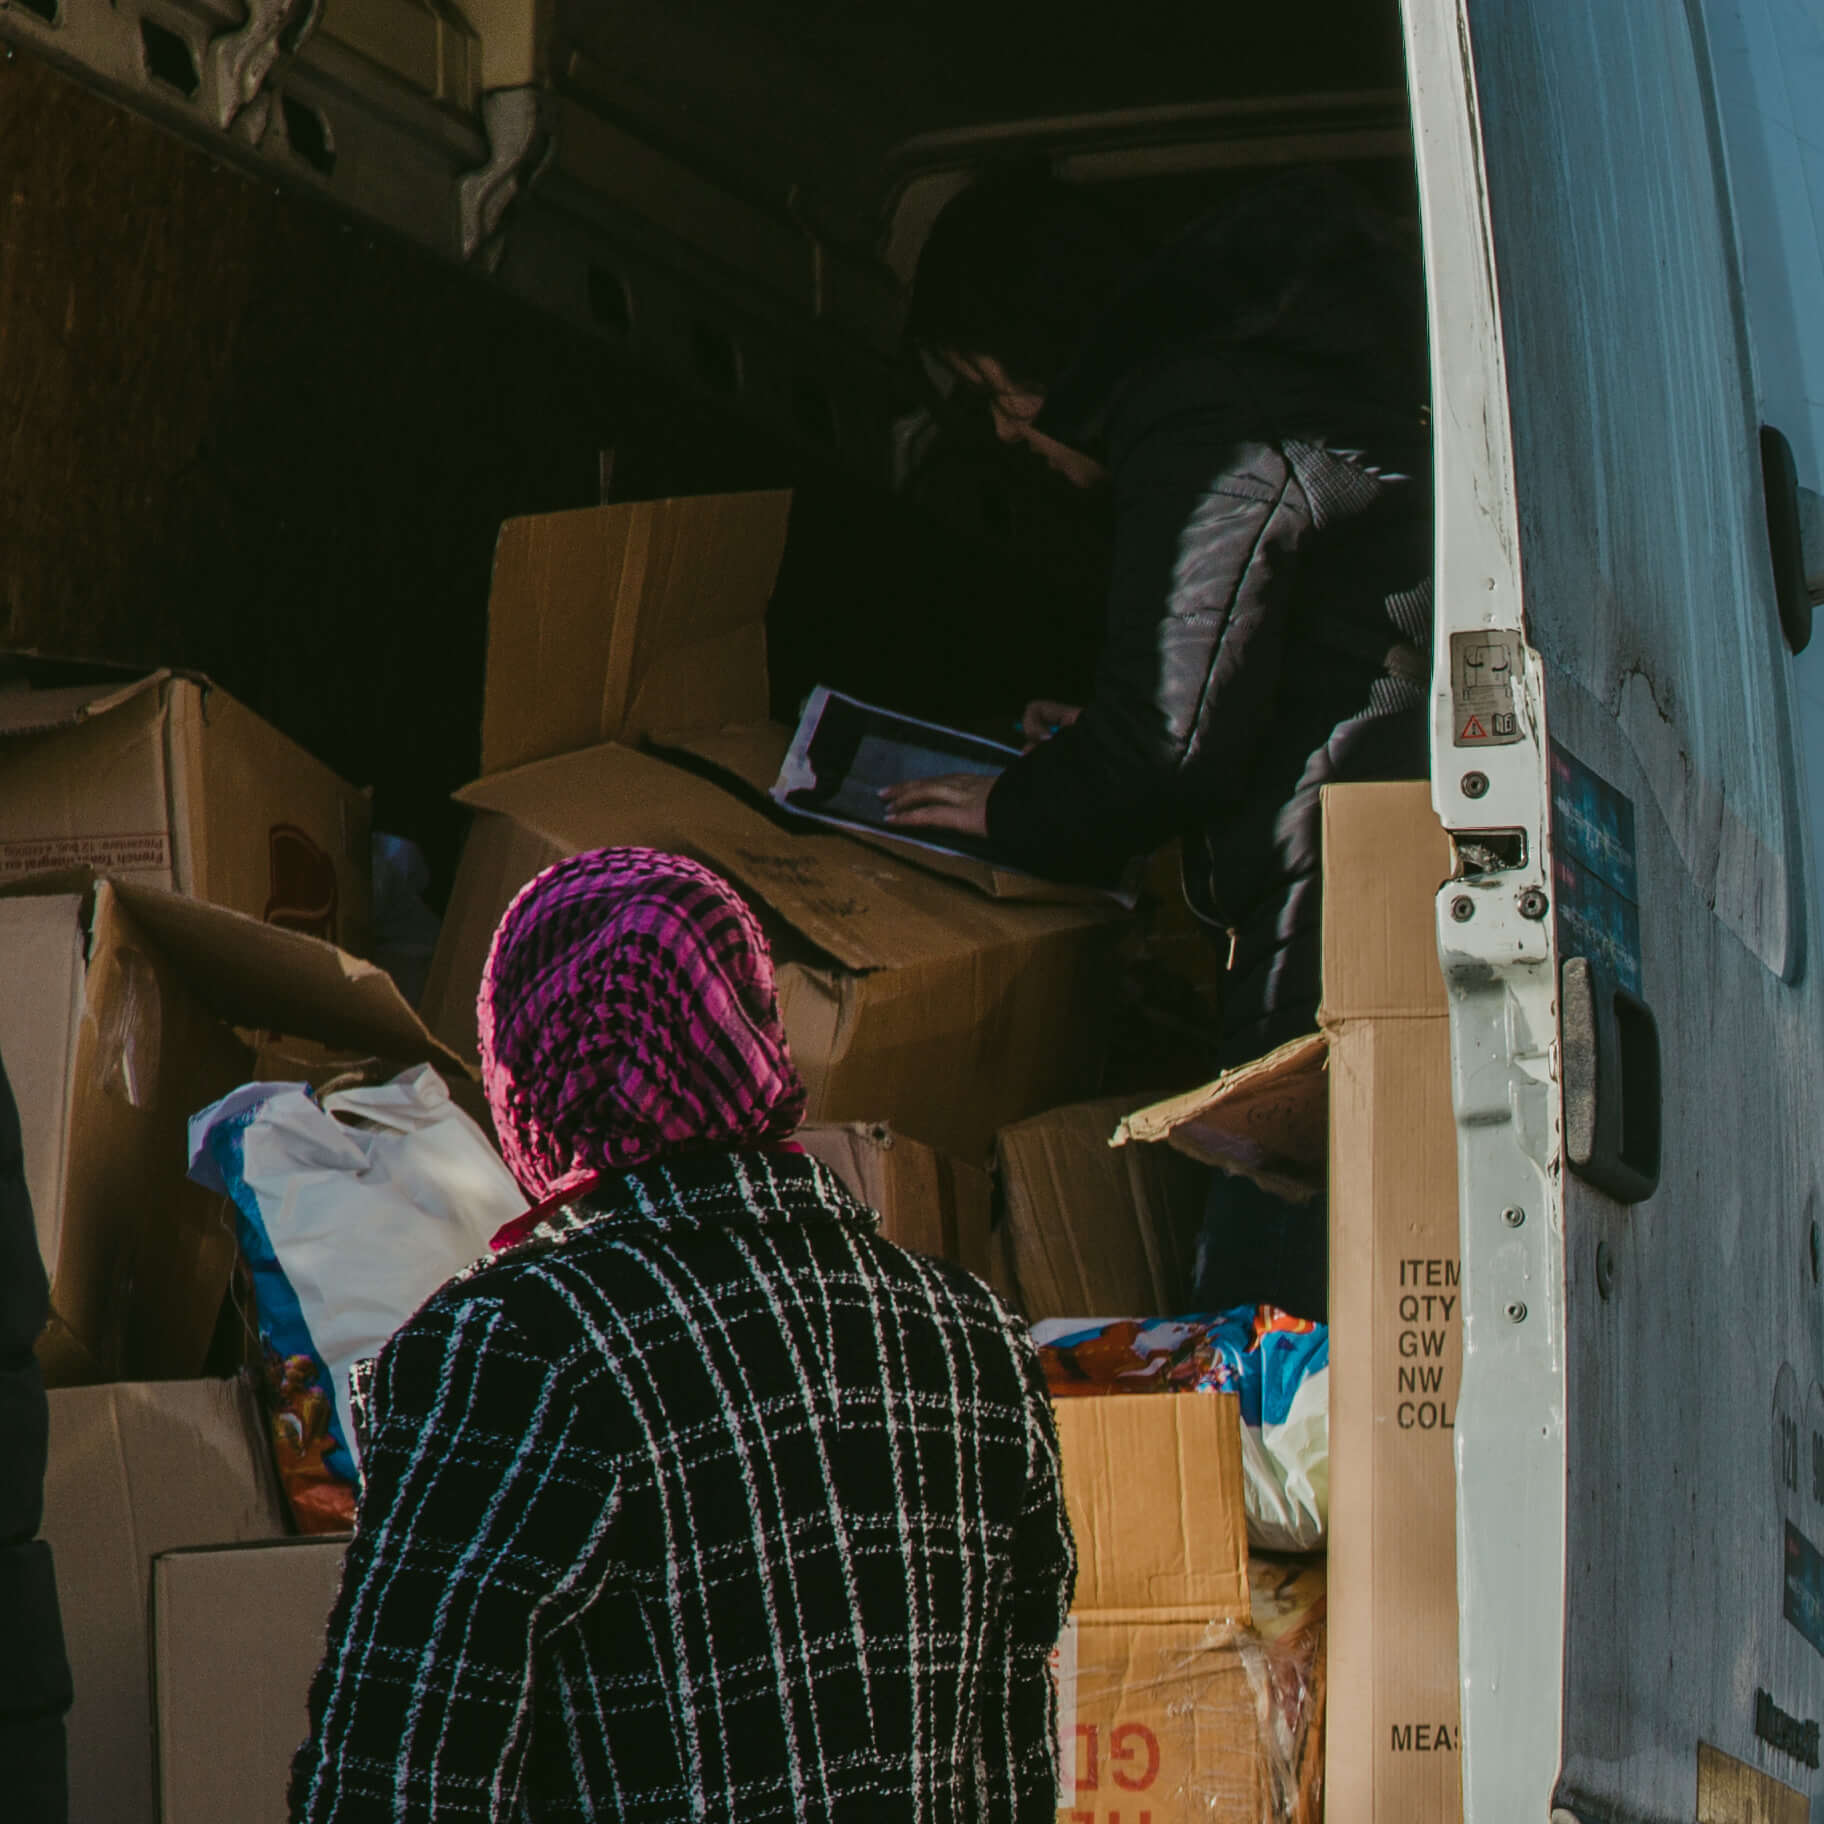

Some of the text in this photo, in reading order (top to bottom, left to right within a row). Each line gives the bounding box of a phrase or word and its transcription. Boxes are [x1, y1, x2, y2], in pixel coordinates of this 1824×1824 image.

[1399, 1295, 1456, 1323] QTY
[1398, 1330, 1446, 1358] GW
[1398, 1366, 1443, 1393] NW
[1391, 1724, 1458, 1752] MEA
